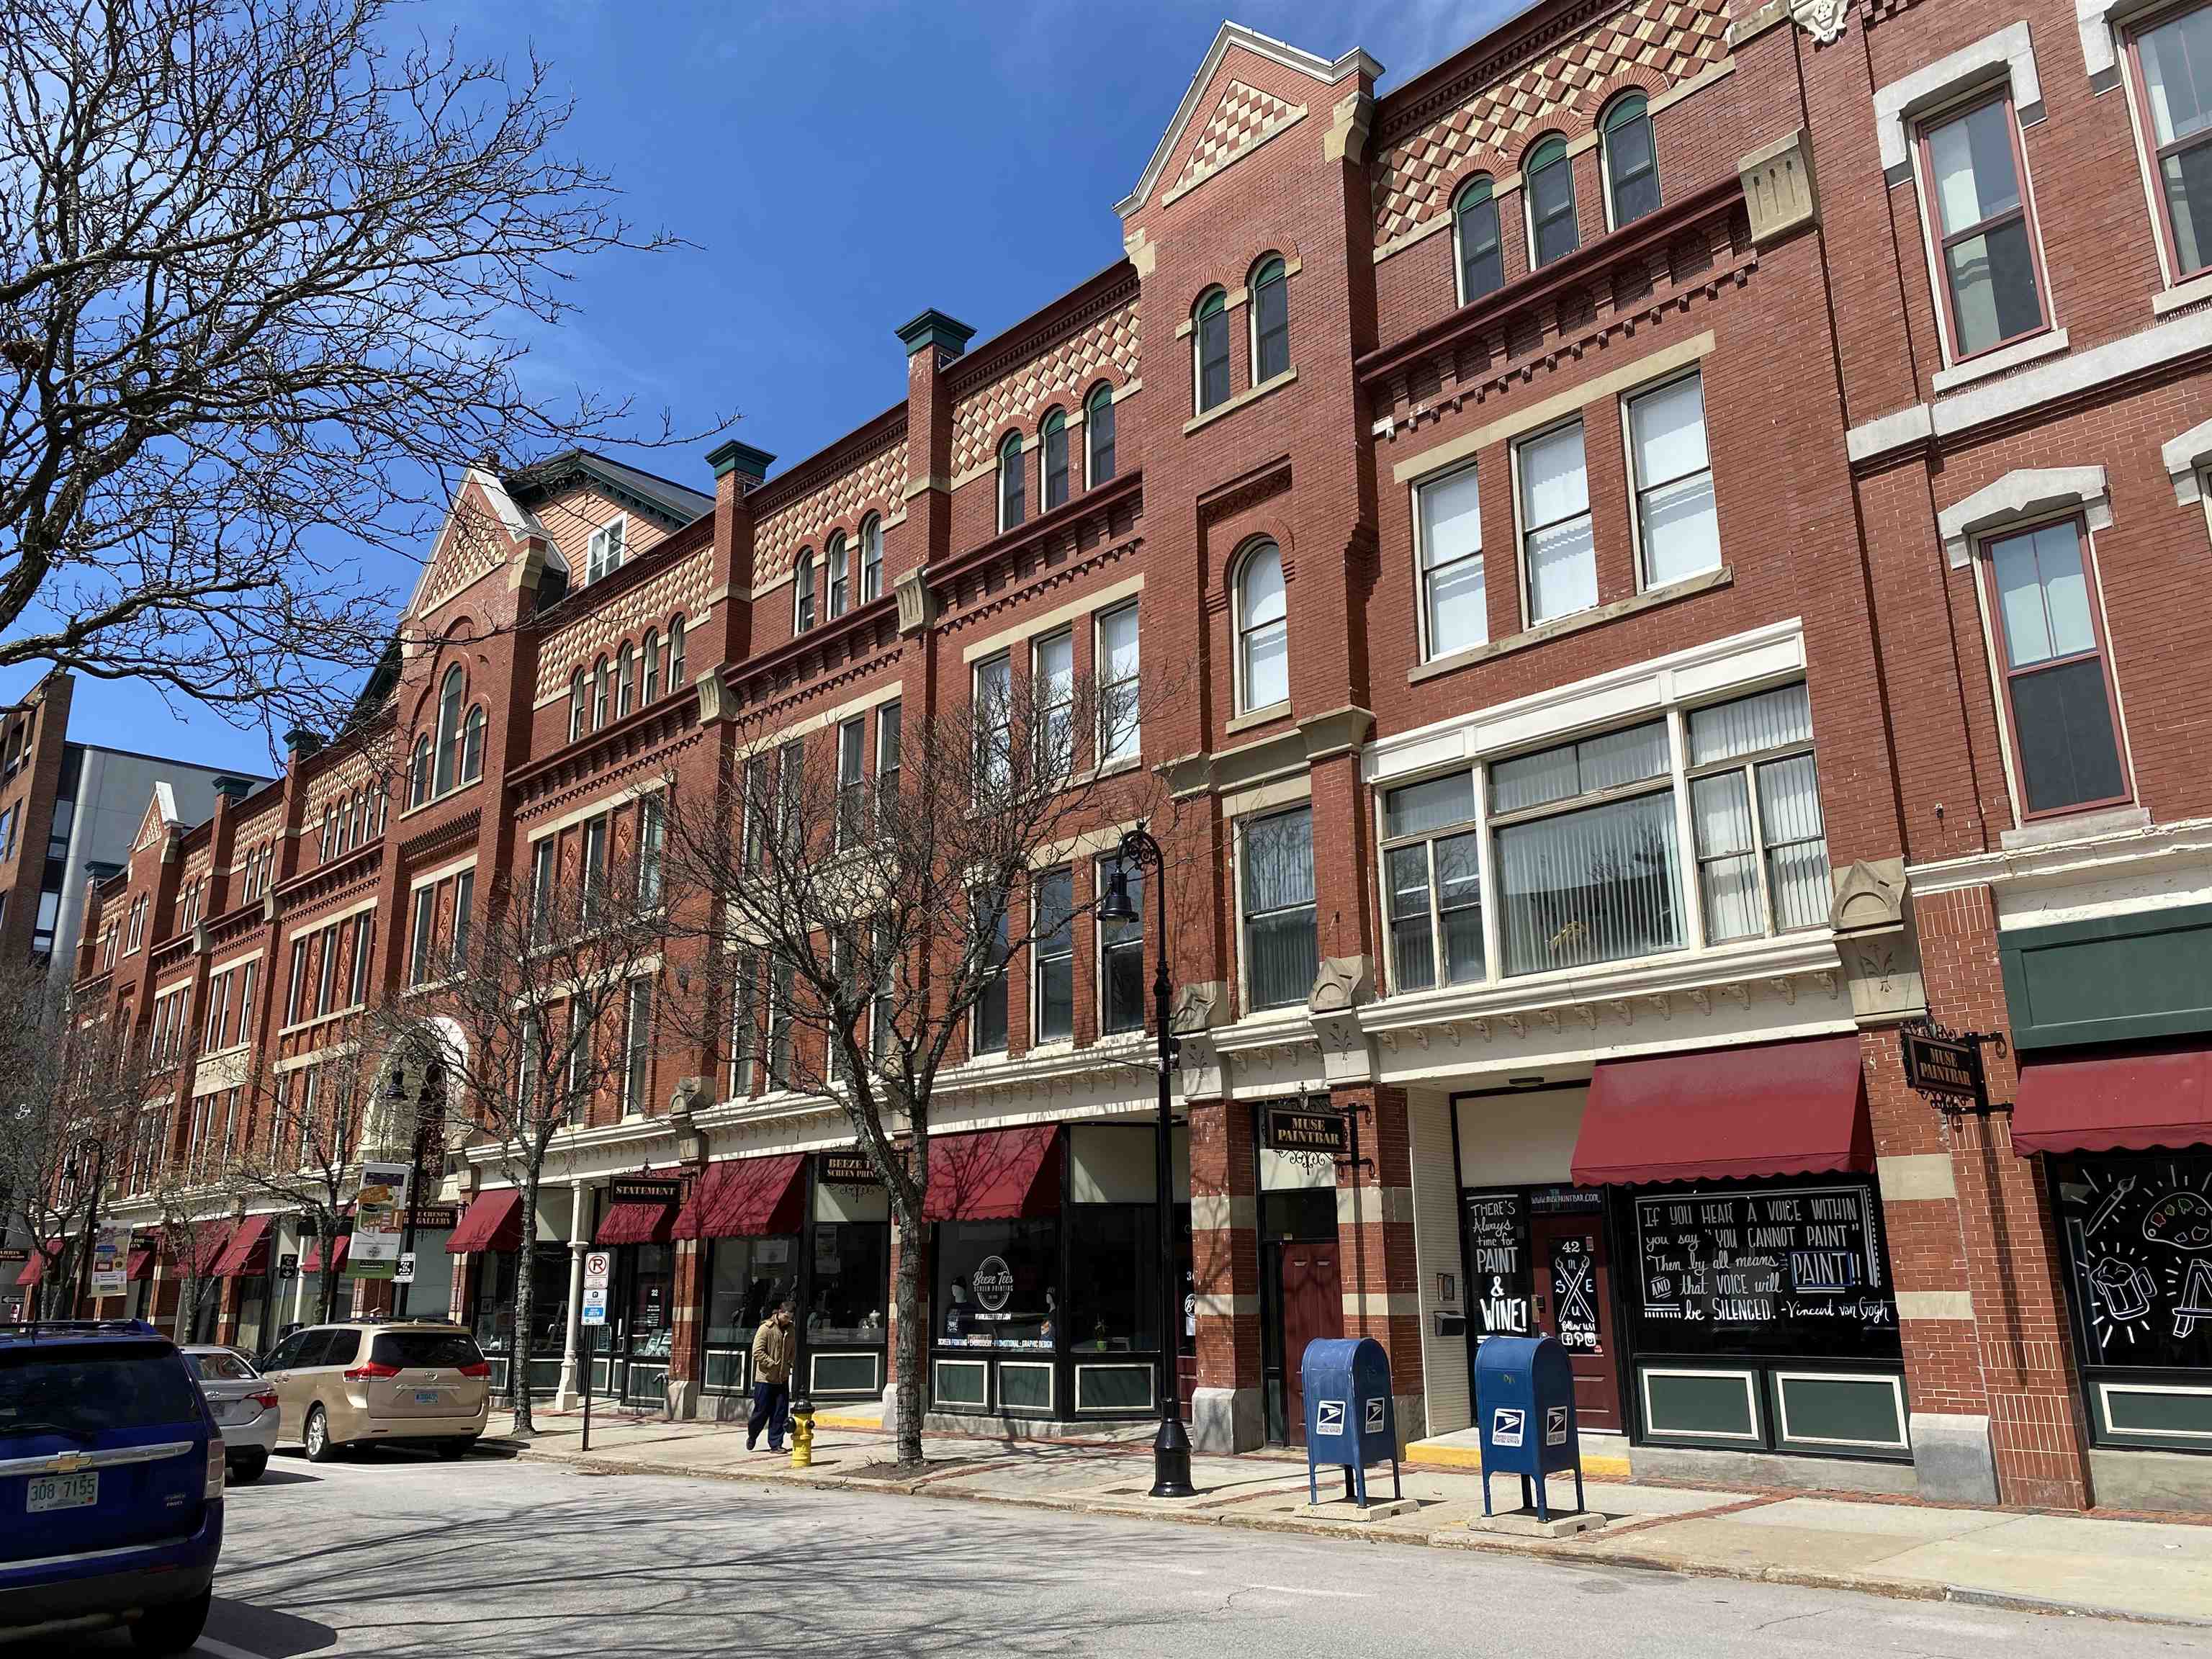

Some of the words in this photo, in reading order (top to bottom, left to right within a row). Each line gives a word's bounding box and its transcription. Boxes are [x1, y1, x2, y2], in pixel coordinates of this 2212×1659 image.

[1930, 1048, 1959, 1067] MUSE
[1920, 1062, 1972, 1086] PAINTBAR
[1292, 1118, 1326, 1130] MUSE
[1278, 1129, 1340, 1145] PAINTBAR
[829, 1159, 863, 1169] BEEZE
[616, 1185, 676, 1195] STATEMENT
[1470, 1200, 1516, 1216] THERE'S
[1701, 1203, 1734, 1223] HEAR
[1747, 1202, 1757, 1222] A
[1766, 1200, 1802, 1221] VOICE
[1810, 1197, 1858, 1220] WITHIN
[1473, 1216, 1514, 1237] Always
[1476, 1235, 1498, 1246] time
[1501, 1232, 1515, 1246] for
[1562, 1241, 1581, 1253] 42
[1646, 1236, 1670, 1252] you
[1678, 1233, 1701, 1251] say
[1748, 1226, 1796, 1248] CANNOT
[1476, 1246, 1519, 1273] PAINT
[1646, 1254, 1685, 1272] Then
[1688, 1251, 1709, 1276] by
[1712, 1250, 1730, 1269] all
[1735, 1255, 1779, 1268] means
[973, 1270, 997, 1286] Beeze
[997, 1270, 1014, 1285] Tees
[1491, 1276, 1505, 1297] &
[1555, 1279, 1567, 1294] S
[1586, 1279, 1595, 1292] E
[1651, 1278, 1671, 1296] AND
[1678, 1274, 1709, 1295] that
[1717, 1274, 1749, 1295] VOICE
[1755, 1272, 1784, 1293] will
[1479, 1298, 1527, 1332] WINE!
[1684, 1300, 1705, 1321] be
[1712, 1298, 1777, 1321] SILENCED.
[1838, 1305, 1858, 1318] van
[1859, 1297, 1890, 1324] Gogh
[30, 1483, 55, 1501] 308
[63, 1478, 94, 1498] 7155
